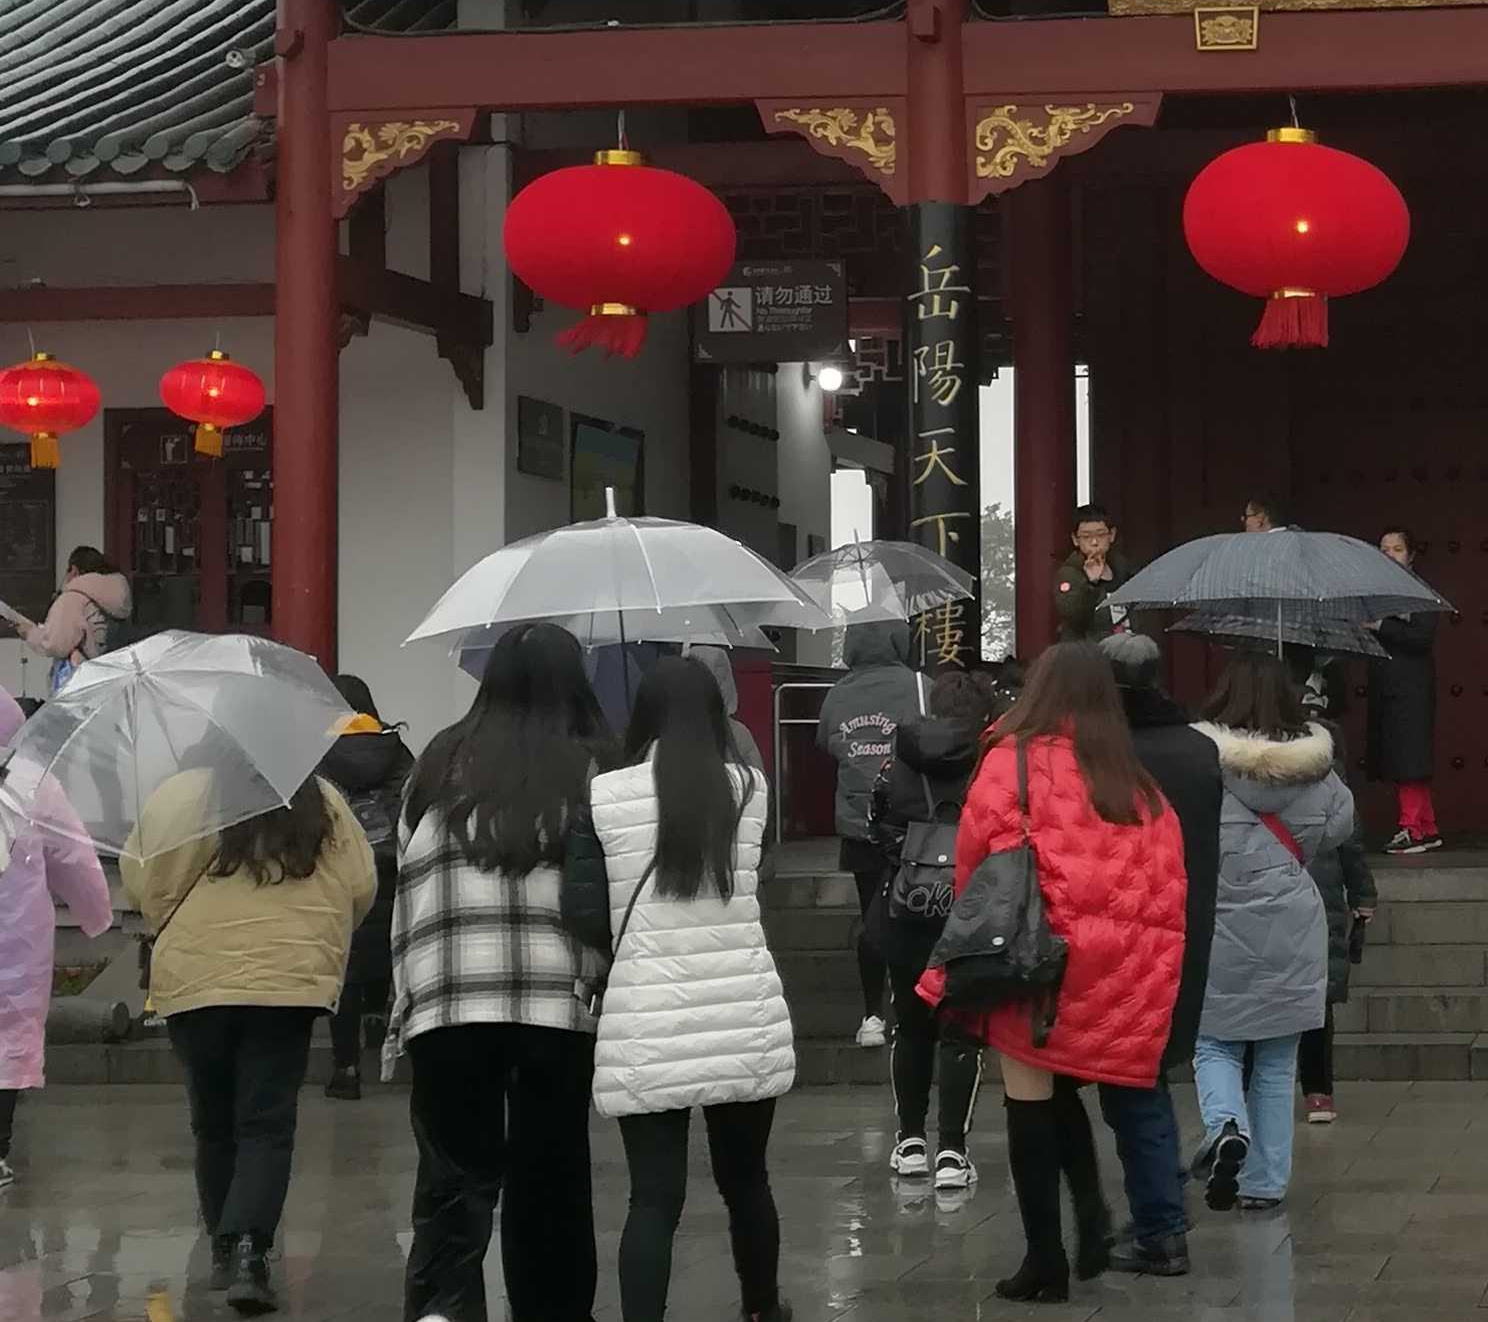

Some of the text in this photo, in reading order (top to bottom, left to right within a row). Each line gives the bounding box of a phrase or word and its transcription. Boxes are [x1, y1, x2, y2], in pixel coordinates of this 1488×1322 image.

[754, 284, 833, 305] 请勿通过
[839, 711, 898, 741] Amusing
[847, 740, 893, 758] Season
